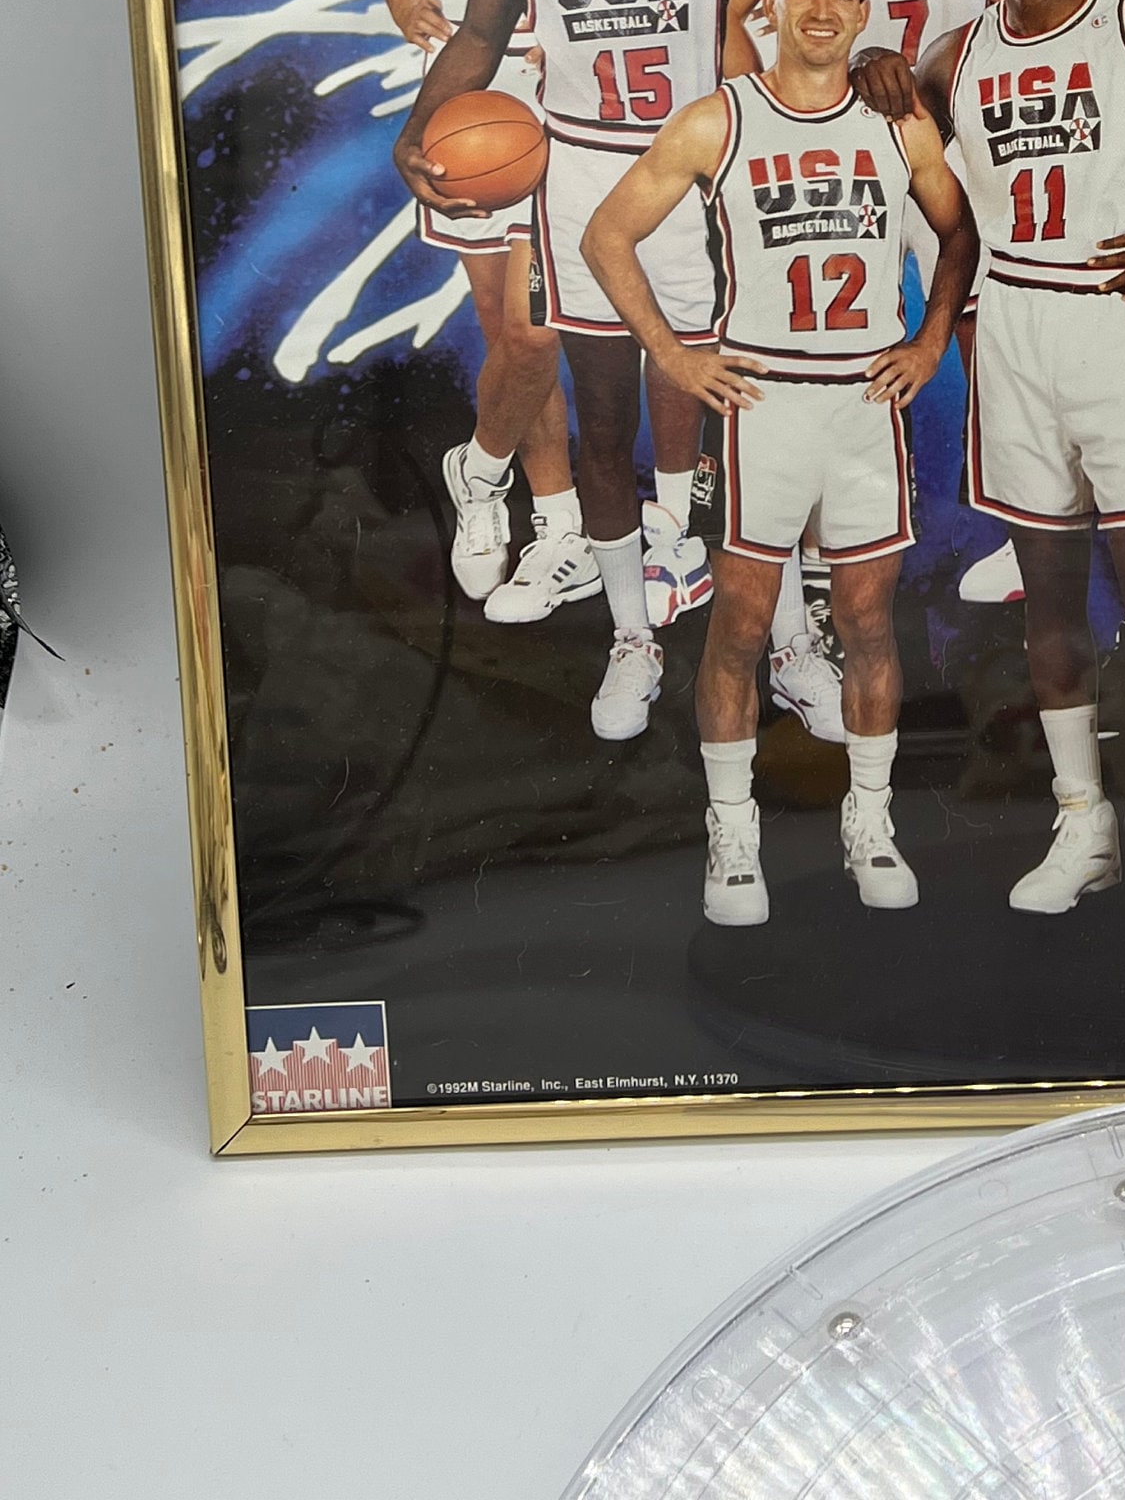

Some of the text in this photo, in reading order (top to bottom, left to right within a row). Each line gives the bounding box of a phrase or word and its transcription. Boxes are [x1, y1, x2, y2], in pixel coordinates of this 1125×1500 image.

[571, 14, 653, 35] BASKETBALL
[593, 45, 673, 122] 15
[977, 61, 1102, 134] USA
[748, 148, 888, 215] USA
[1010, 164, 1067, 243] 11
[771, 218, 853, 240] BASKETBALL
[786, 252, 869, 333] 12
[252, 1085, 388, 1113] STARLINE
[481, 1079, 535, 1093] Starline,
[541, 1078, 569, 1092] Inc.,
[575, 1077, 604, 1089] East
[606, 1075, 668, 1089] Elmhurst,
[674, 1073, 700, 1086] N.Y.
[702, 1073, 739, 1086] 11370
